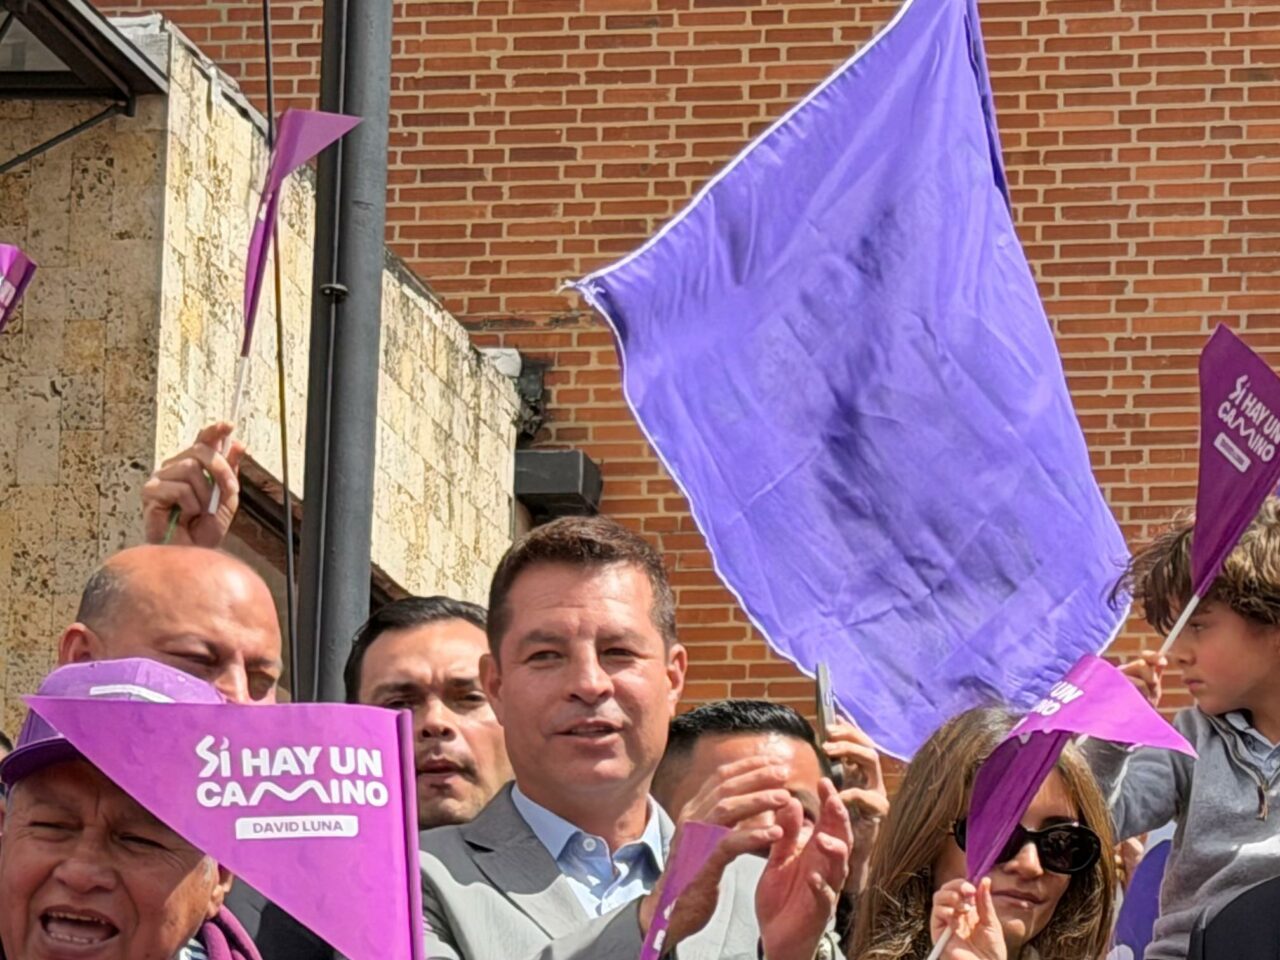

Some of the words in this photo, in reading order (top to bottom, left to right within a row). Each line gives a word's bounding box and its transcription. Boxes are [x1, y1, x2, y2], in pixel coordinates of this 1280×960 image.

[1240, 391, 1271, 427] HAY
[1217, 400, 1276, 463] CAMINO
[241, 745, 323, 777] HAY
[328, 745, 384, 778] UN
[196, 778, 390, 808] CAMINO
[252, 821, 300, 834] DAVID
[302, 819, 344, 832] LUNA
